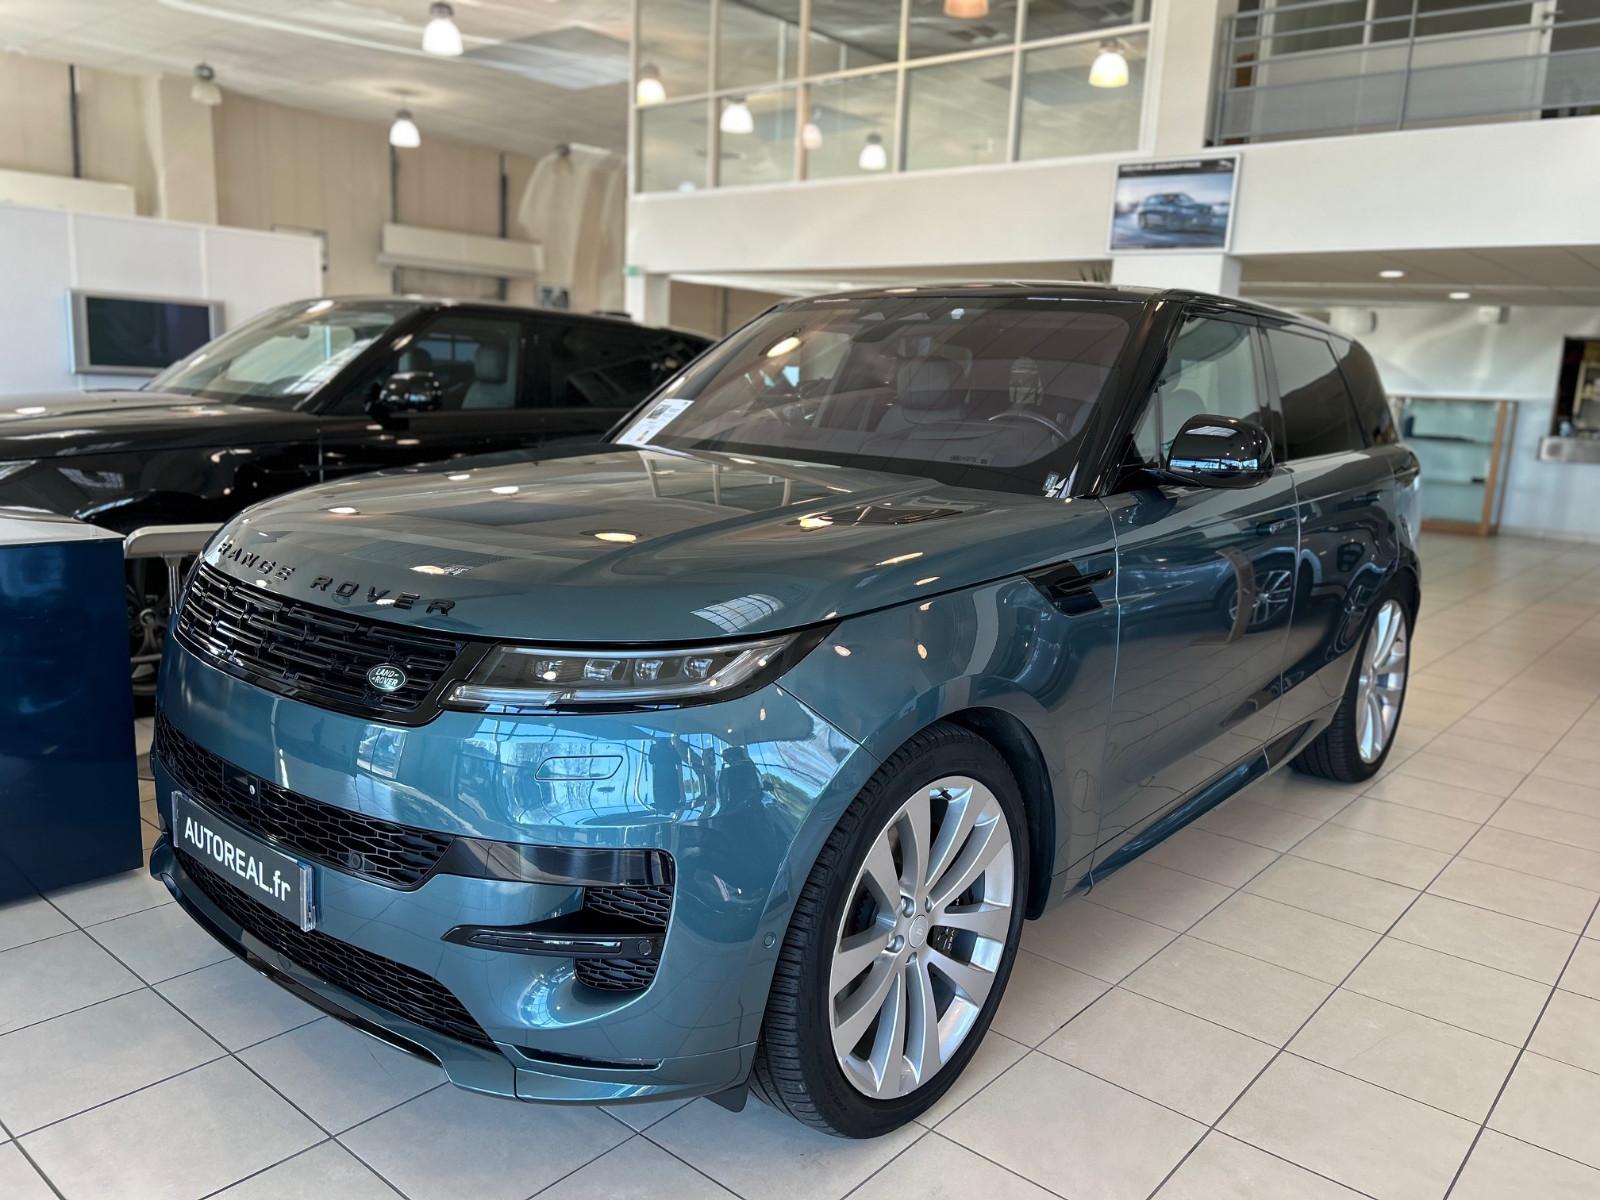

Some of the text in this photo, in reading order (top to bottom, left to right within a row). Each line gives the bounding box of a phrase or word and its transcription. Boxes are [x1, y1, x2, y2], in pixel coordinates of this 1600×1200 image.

[218, 543, 456, 617] RANGE ROVER
[374, 675, 399, 687] ROVER
[184, 816, 291, 902] AUTOREAL.fr
